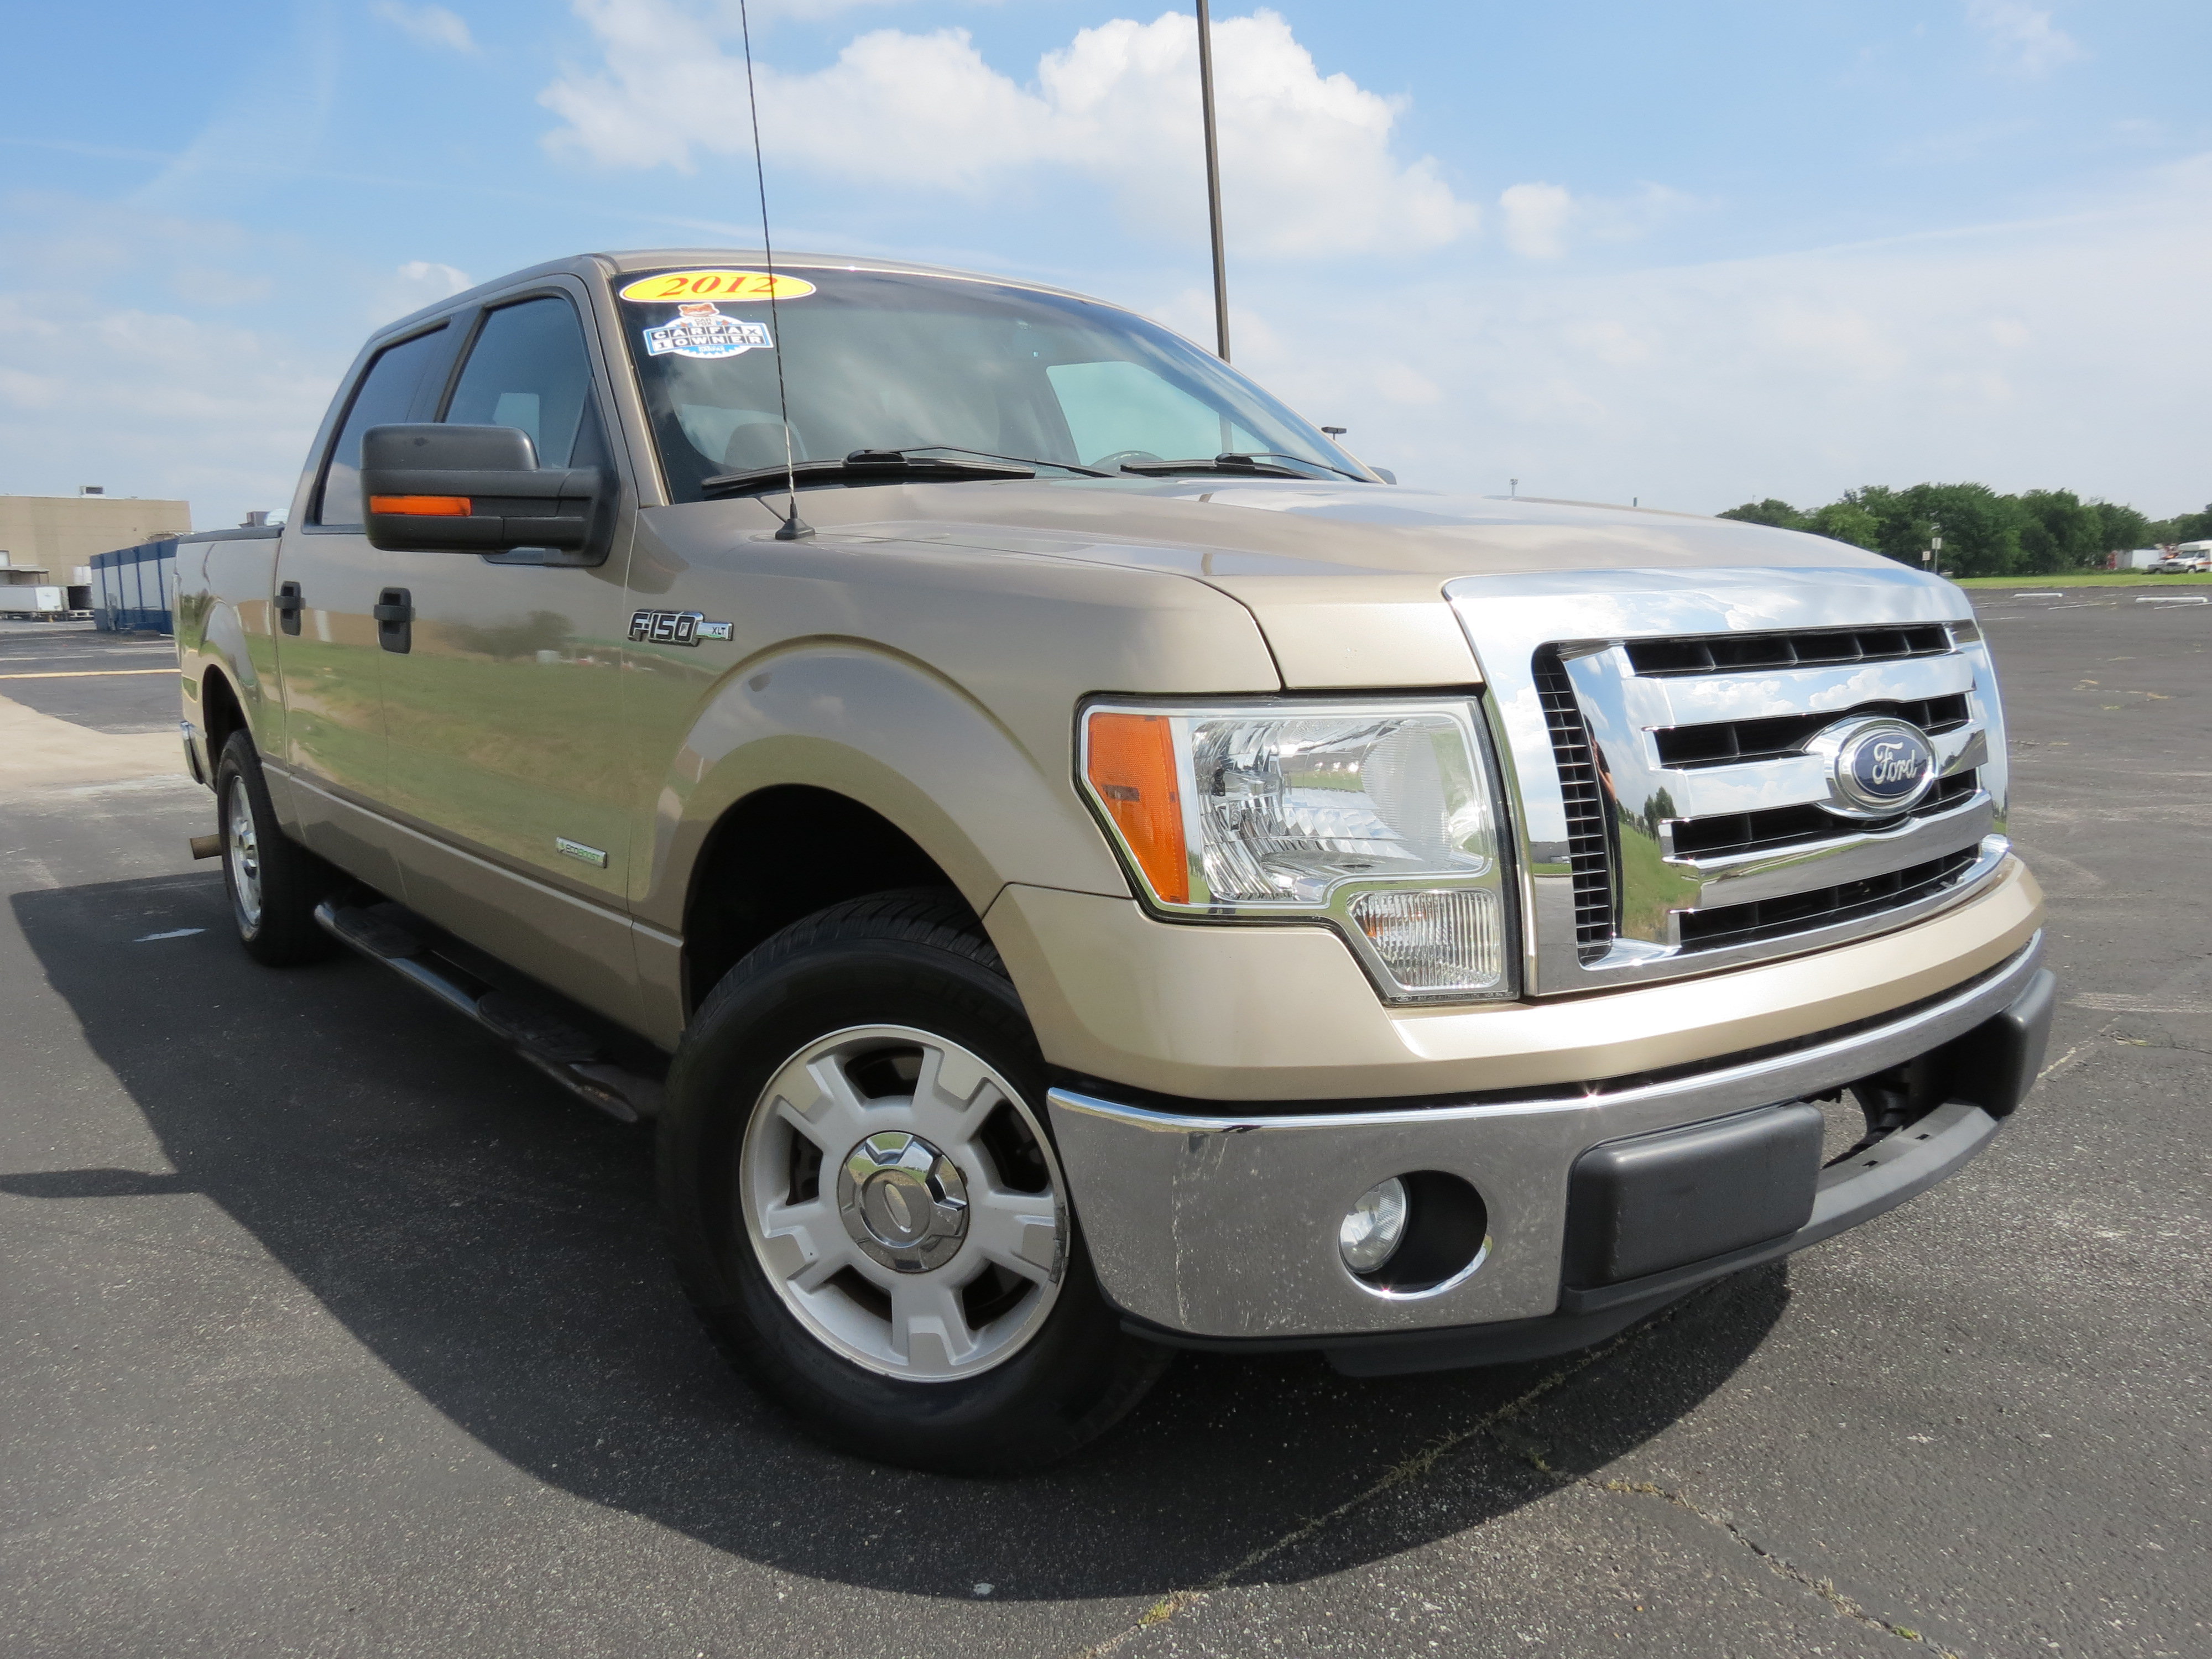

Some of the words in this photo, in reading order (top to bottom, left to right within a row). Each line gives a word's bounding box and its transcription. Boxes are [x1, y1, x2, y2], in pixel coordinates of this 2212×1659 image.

[656, 275, 778, 298] 2012
[654, 326, 758, 340] CARFAX
[656, 341, 668, 349] 1
[675, 336, 763, 346] OWNER
[712, 626, 726, 635] XLT
[1872, 742, 1917, 785] Ford
